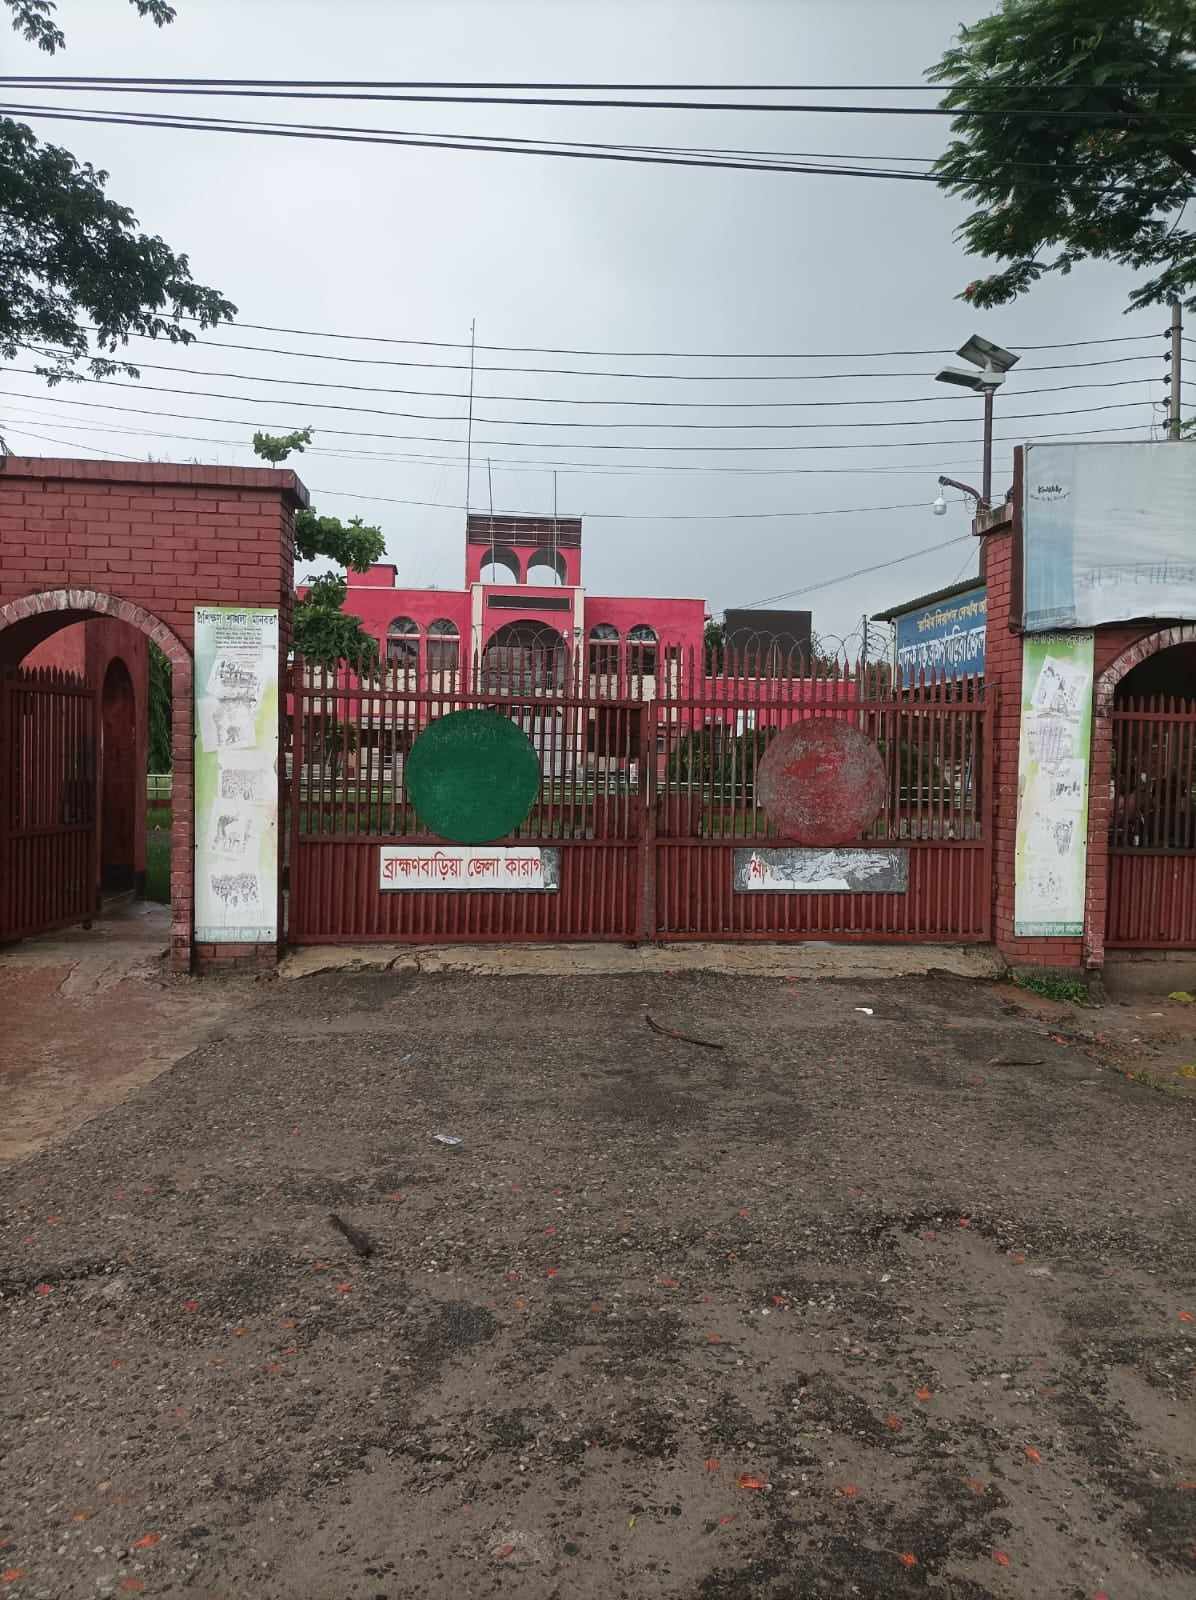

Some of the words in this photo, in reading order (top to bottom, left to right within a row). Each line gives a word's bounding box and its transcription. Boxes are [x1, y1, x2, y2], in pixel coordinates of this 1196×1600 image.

[383, 850, 463, 881] ব্রাহ্মণবাড়িয়া
[467, 858, 501, 877] জেলা
[504, 858, 544, 878] কারাগ
